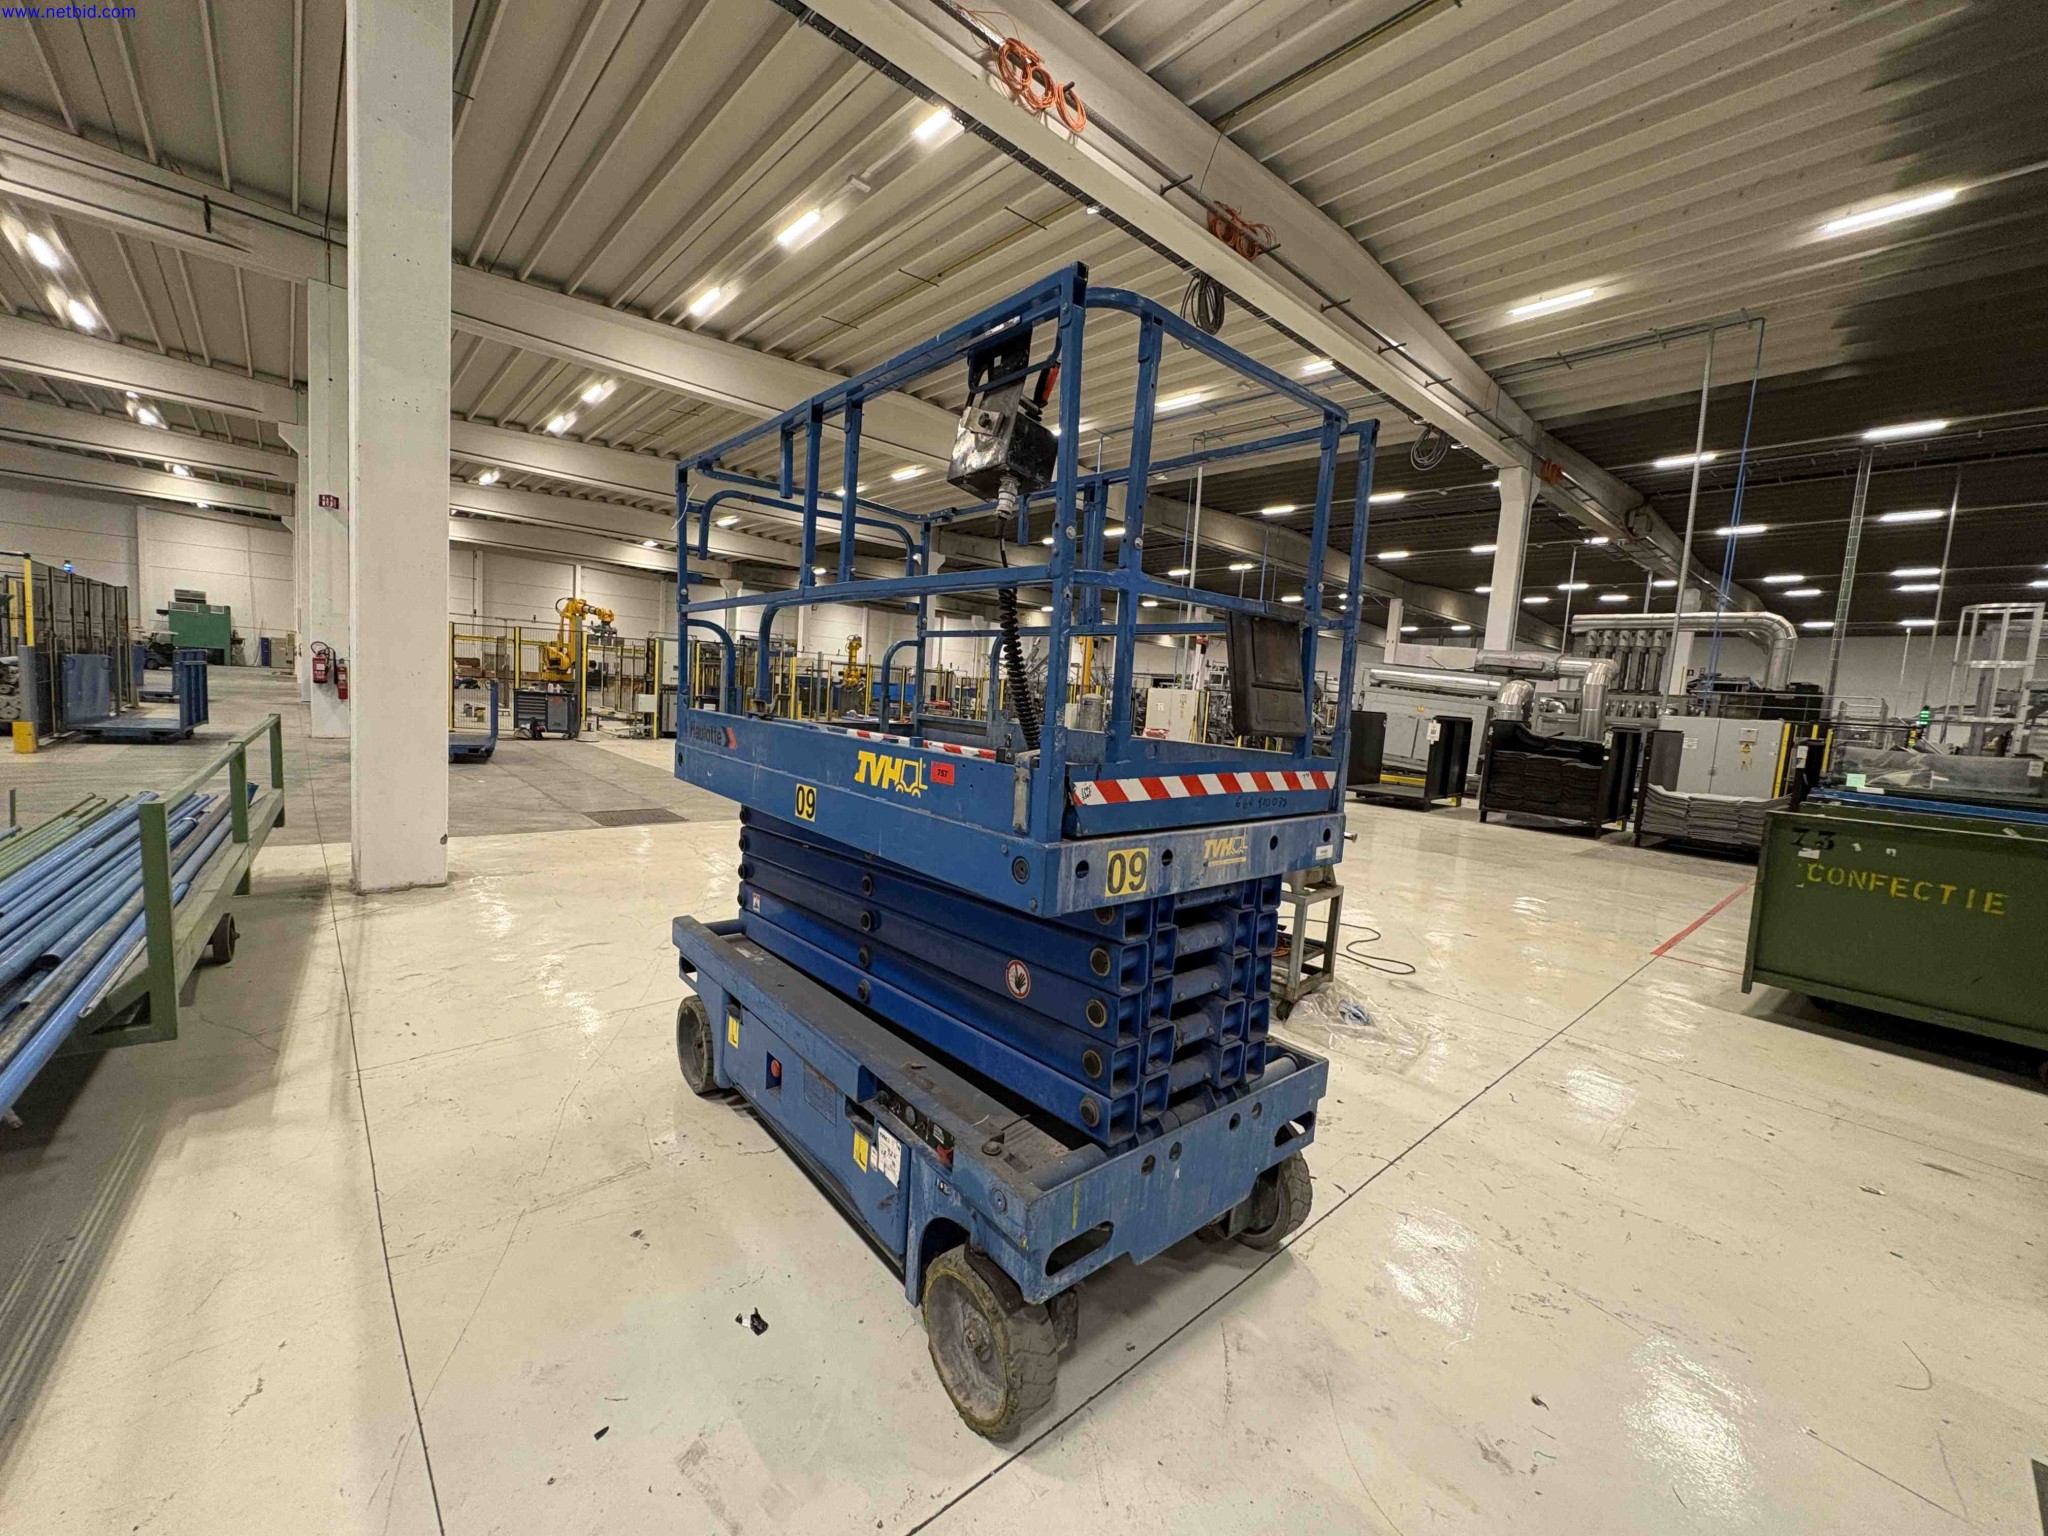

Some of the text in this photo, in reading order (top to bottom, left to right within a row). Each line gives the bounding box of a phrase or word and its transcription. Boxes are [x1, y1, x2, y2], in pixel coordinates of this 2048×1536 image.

[796, 785, 816, 819] 09
[1107, 851, 1147, 895] 09
[1807, 863, 2009, 916] CONFECTIE
